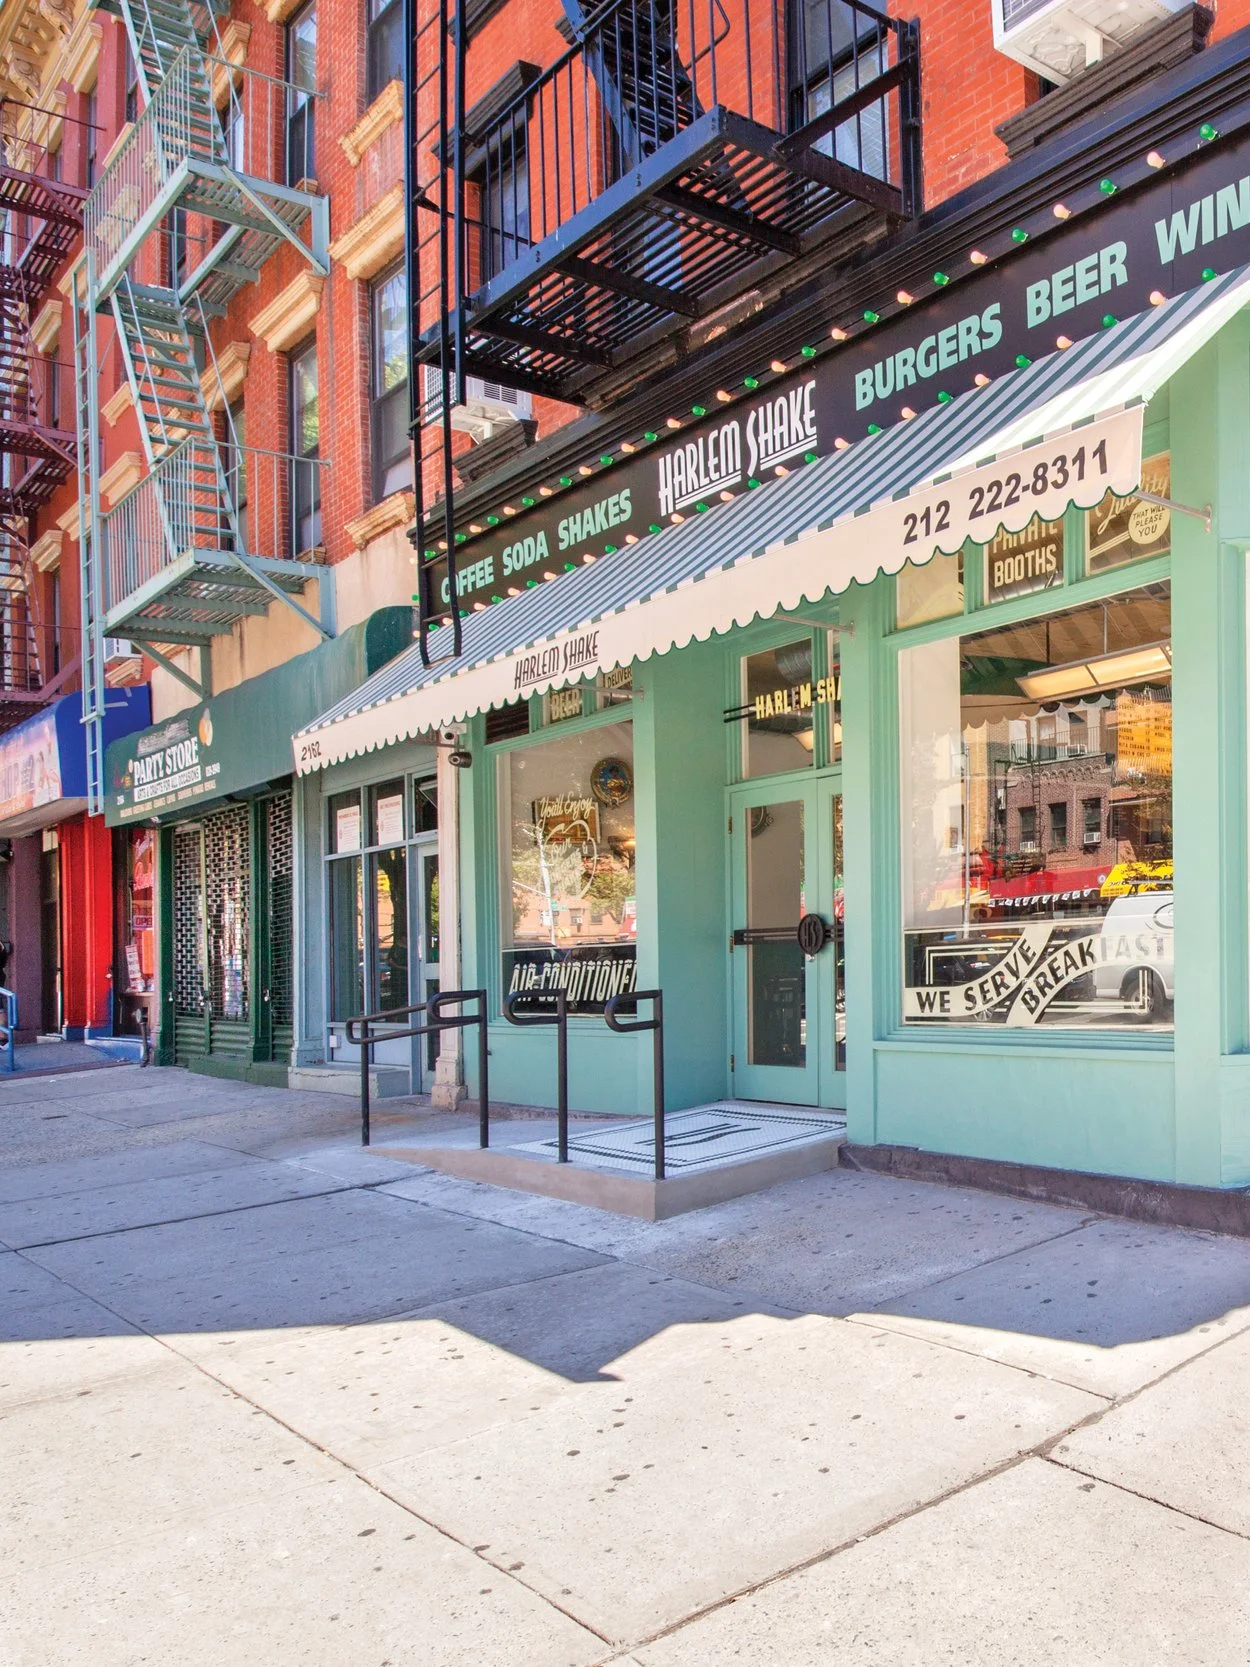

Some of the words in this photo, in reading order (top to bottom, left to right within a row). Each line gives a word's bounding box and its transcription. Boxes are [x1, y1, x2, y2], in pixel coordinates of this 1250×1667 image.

[855, 302, 1003, 411] BURGERS
[1026, 241, 1129, 329] BEER
[658, 419, 742, 517] HARLEM
[745, 379, 818, 477] SHAKE
[903, 500, 951, 546] 212
[968, 438, 1108, 521] 222-8311
[1133, 509, 1149, 520] THAT
[1136, 513, 1163, 528] PLEASE
[1138, 524, 1158, 537] YOU
[441, 555, 495, 604] CFFEE
[502, 530, 550, 576] SODA
[557, 488, 633, 551] SHAKES
[994, 543, 1057, 588] BOOTHS
[513, 645, 560, 691] HARLEM
[561, 630, 600, 674] SHAKE
[607, 668, 633, 688] DELIVER
[755, 683, 812, 720] HARLEM
[133, 751, 164, 786] PARTY
[165, 736, 199, 776] STORE
[302, 741, 322, 761] 2162
[136, 917, 153, 928] OPE
[508, 962, 538, 1002] AIR
[916, 991, 951, 1014] WE
[963, 938, 1037, 1012] SERVE
